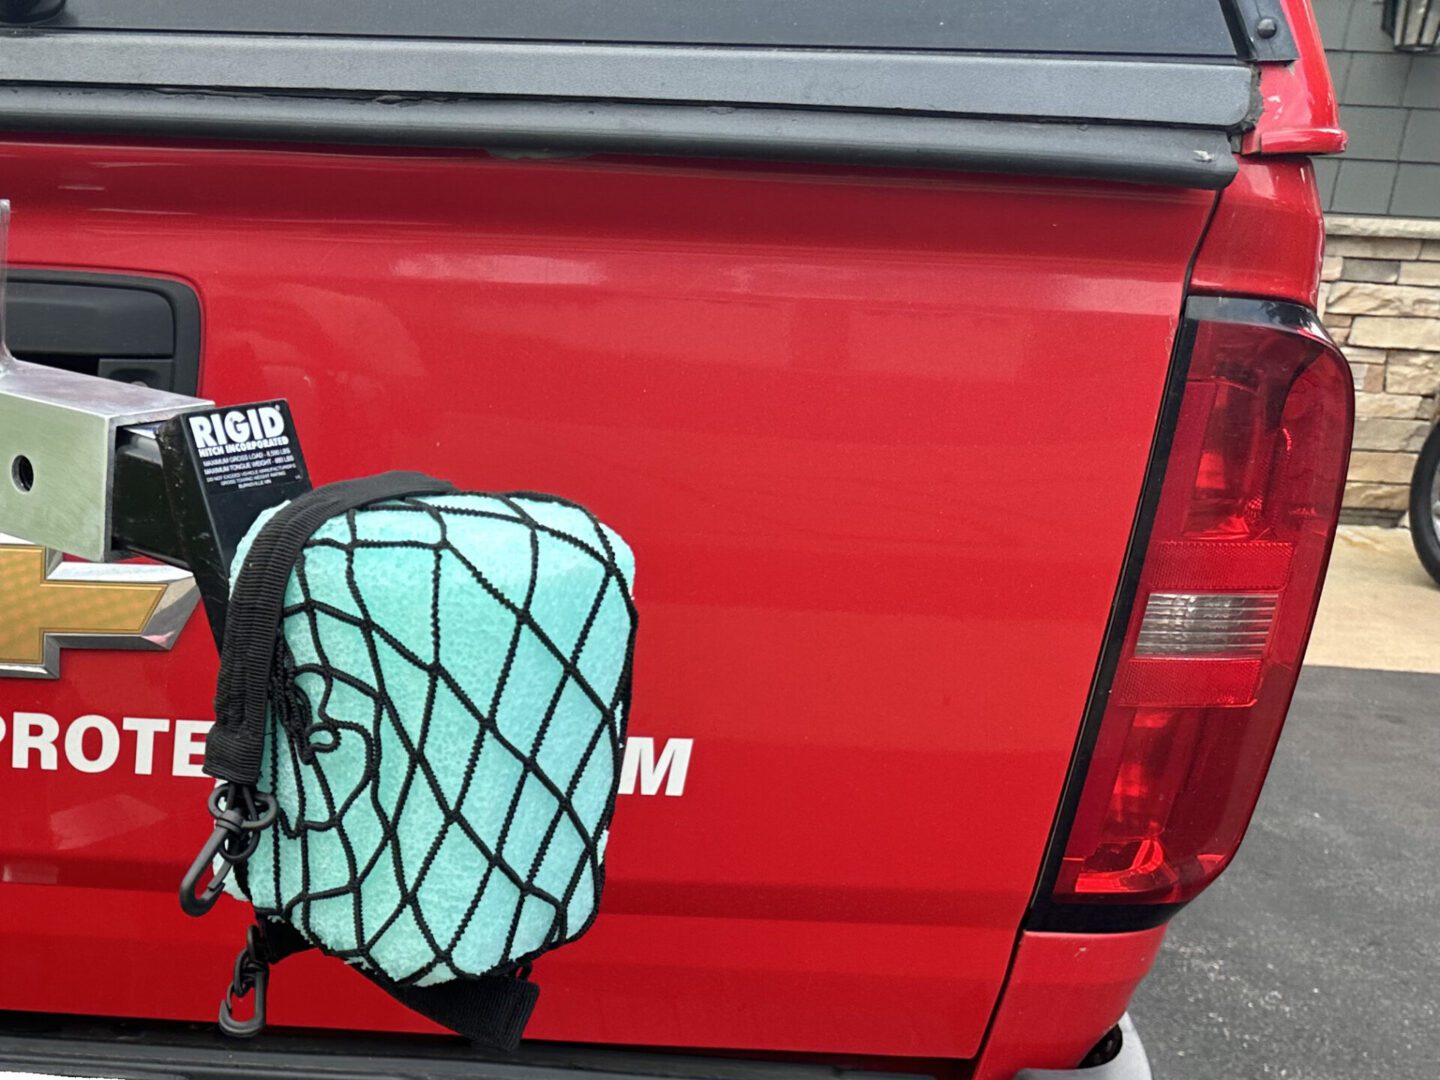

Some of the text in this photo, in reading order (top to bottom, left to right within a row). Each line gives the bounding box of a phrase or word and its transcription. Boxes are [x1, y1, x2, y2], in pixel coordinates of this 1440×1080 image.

[189, 406, 285, 448] RIGID
[198, 436, 289, 458] HITCH INCORPORATED
